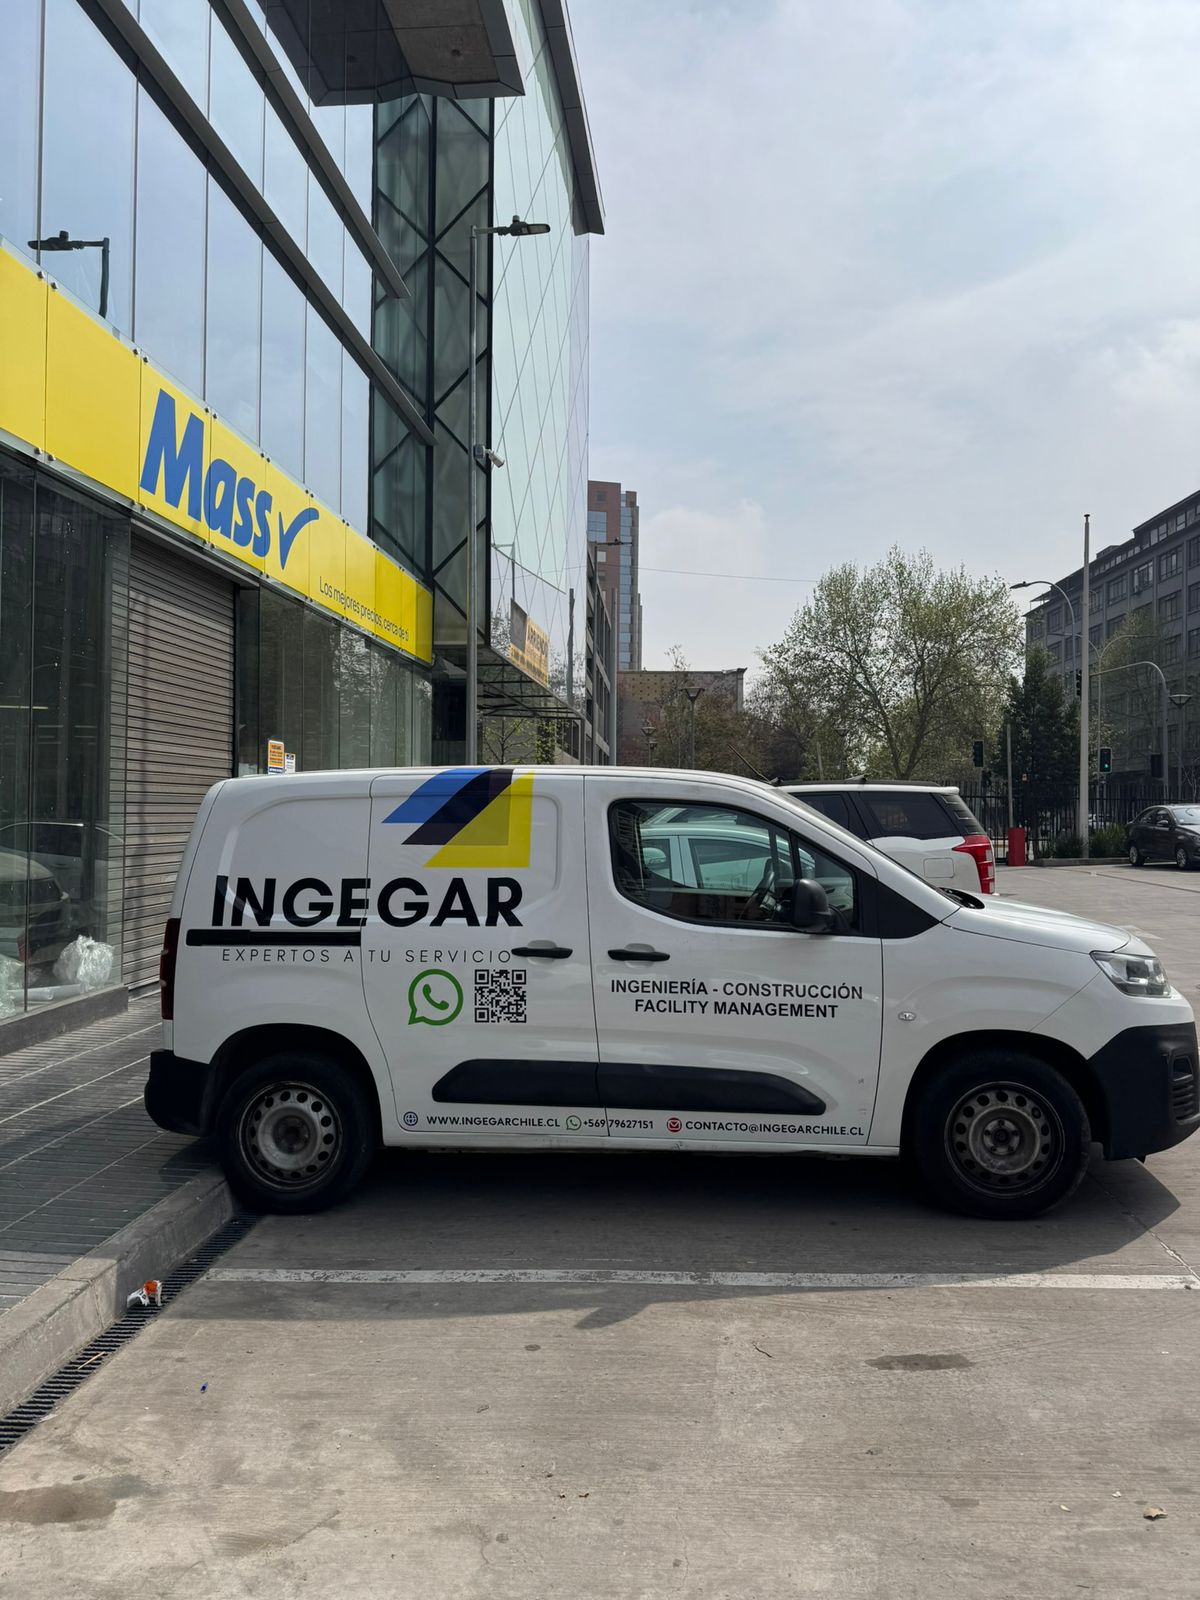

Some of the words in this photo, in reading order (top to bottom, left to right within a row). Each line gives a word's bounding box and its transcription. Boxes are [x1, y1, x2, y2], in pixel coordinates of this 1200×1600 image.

[140, 388, 273, 558] Mass
[211, 874, 524, 928] INGEGAR
[222, 947, 331, 964] EXPERTOS
[343, 948, 354, 963] A
[369, 949, 391, 964] TU
[405, 949, 512, 964] SERVICIO
[610, 978, 709, 996] INGENIERÍA
[722, 981, 863, 1000] CONSTRUCCIÓN
[634, 999, 709, 1014] FACILITY
[713, 1001, 839, 1018] MANAGEMENT
[426, 1115, 561, 1128] WWW.INGEGARCHILE.CL
[685, 1120, 865, 1136] CONTACTO@INGEGARCHILE.CL
